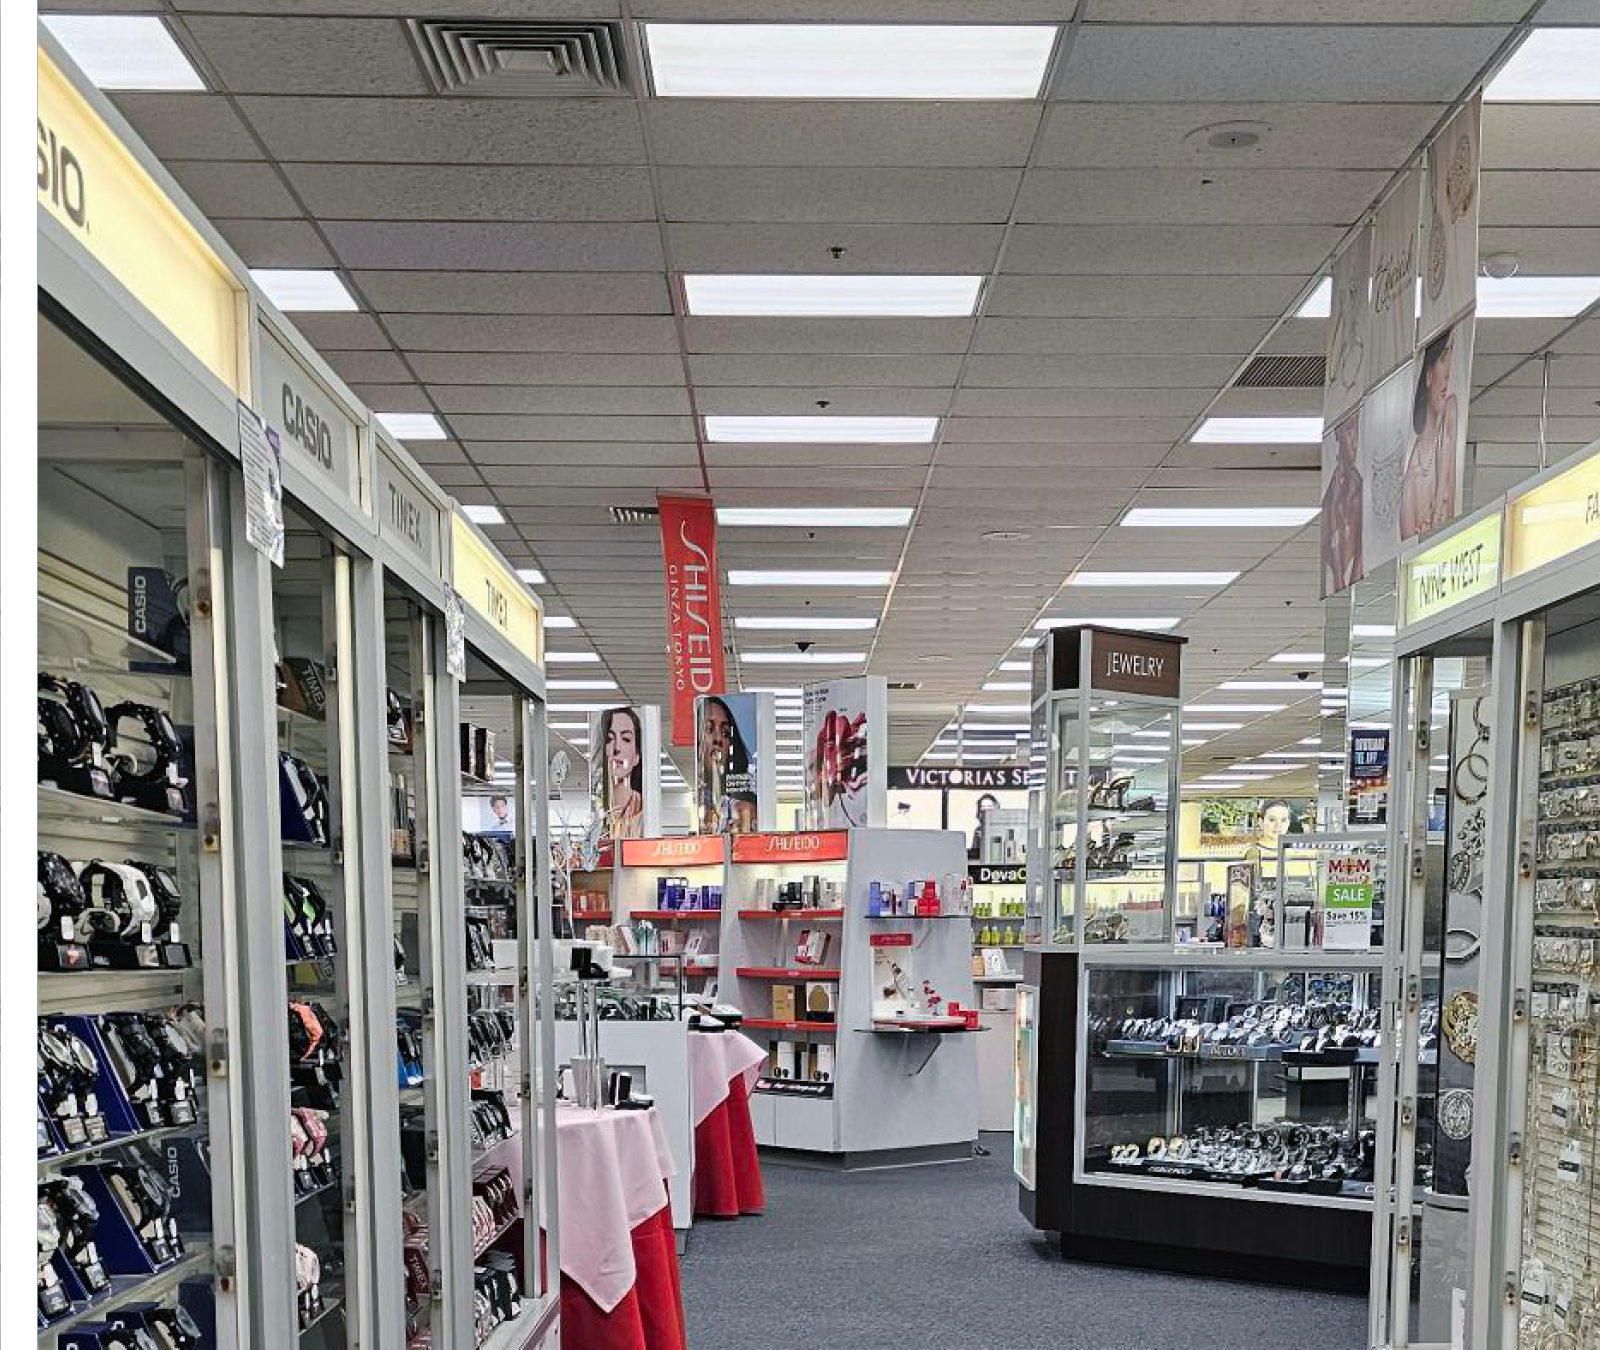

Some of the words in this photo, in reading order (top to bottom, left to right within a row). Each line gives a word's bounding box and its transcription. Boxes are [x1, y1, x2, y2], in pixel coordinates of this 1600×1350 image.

[281, 383, 332, 467] CASIO
[387, 481, 423, 547] TIMEX
[669, 564, 681, 623] GINZA
[1419, 561, 1447, 608] NINE
[1450, 544, 1483, 589] WEST
[133, 575, 146, 634] CASIO
[484, 577, 508, 631] TIMEX
[681, 520, 714, 699] SHISEID
[673, 632, 686, 690] TOKYO
[1106, 650, 1164, 679] JEWELRY
[654, 840, 702, 857] SHISEIDO
[765, 835, 820, 852] SHISEIDO
[980, 868, 1026, 883] DevaC
[1333, 889, 1365, 901] SALE
[1326, 911, 1347, 921] Save
[1350, 911, 1367, 921] 15%
[167, 1147, 181, 1199] CASIO
